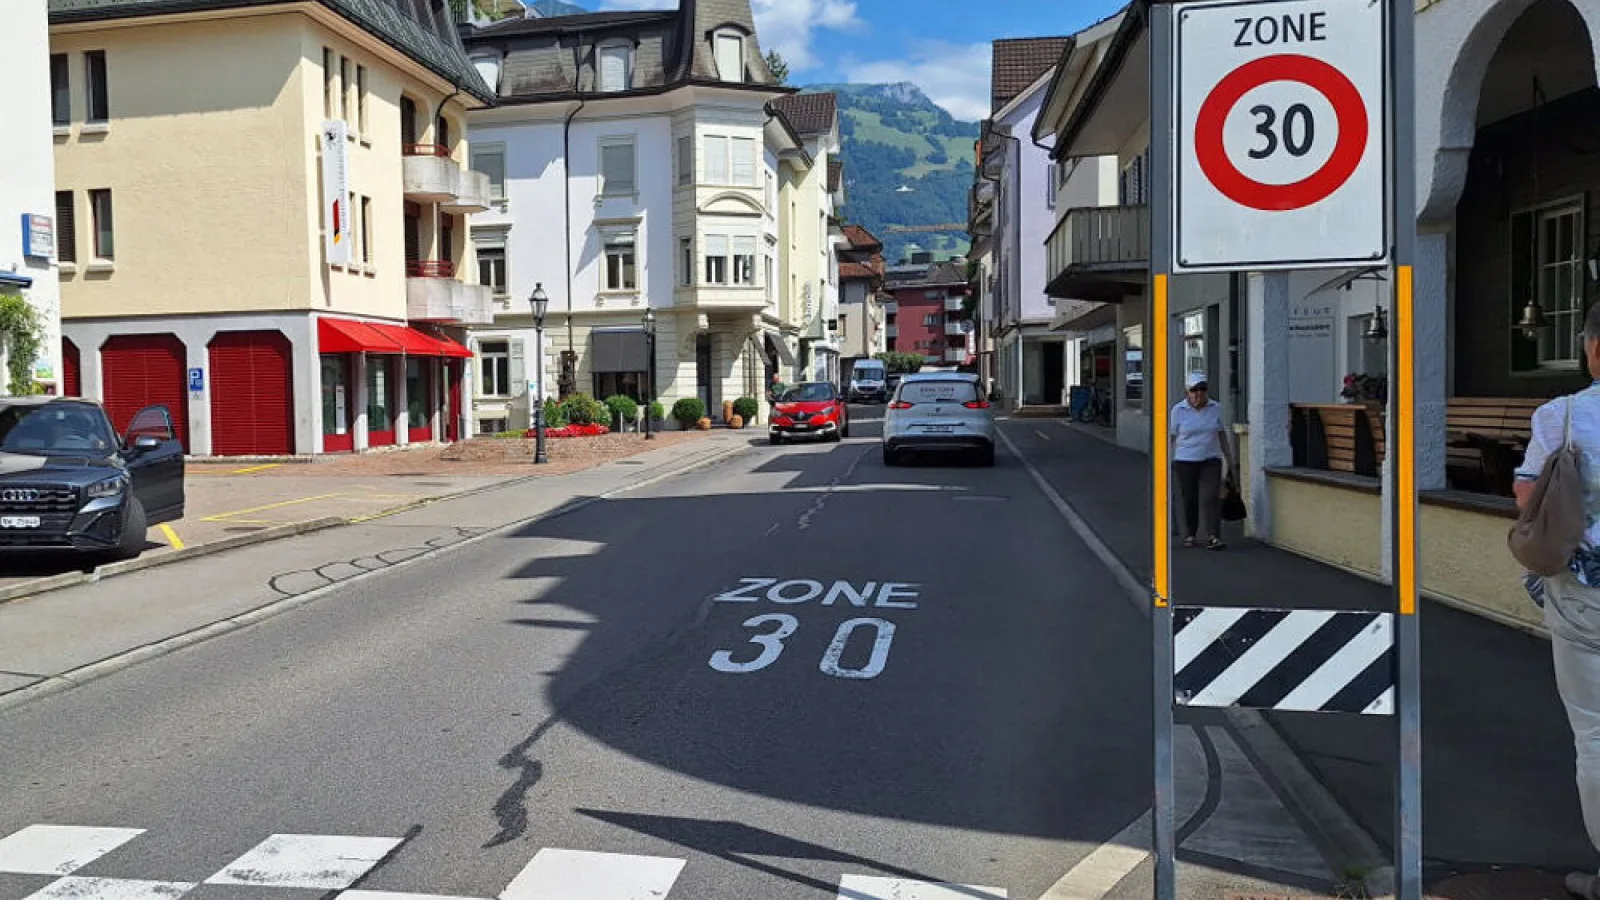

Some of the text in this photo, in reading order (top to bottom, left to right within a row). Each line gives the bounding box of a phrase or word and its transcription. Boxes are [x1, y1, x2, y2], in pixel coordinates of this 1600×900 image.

[1234, 12, 1327, 47] ZONE
[1248, 103, 1315, 160] 30
[713, 577, 922, 609] ZONE
